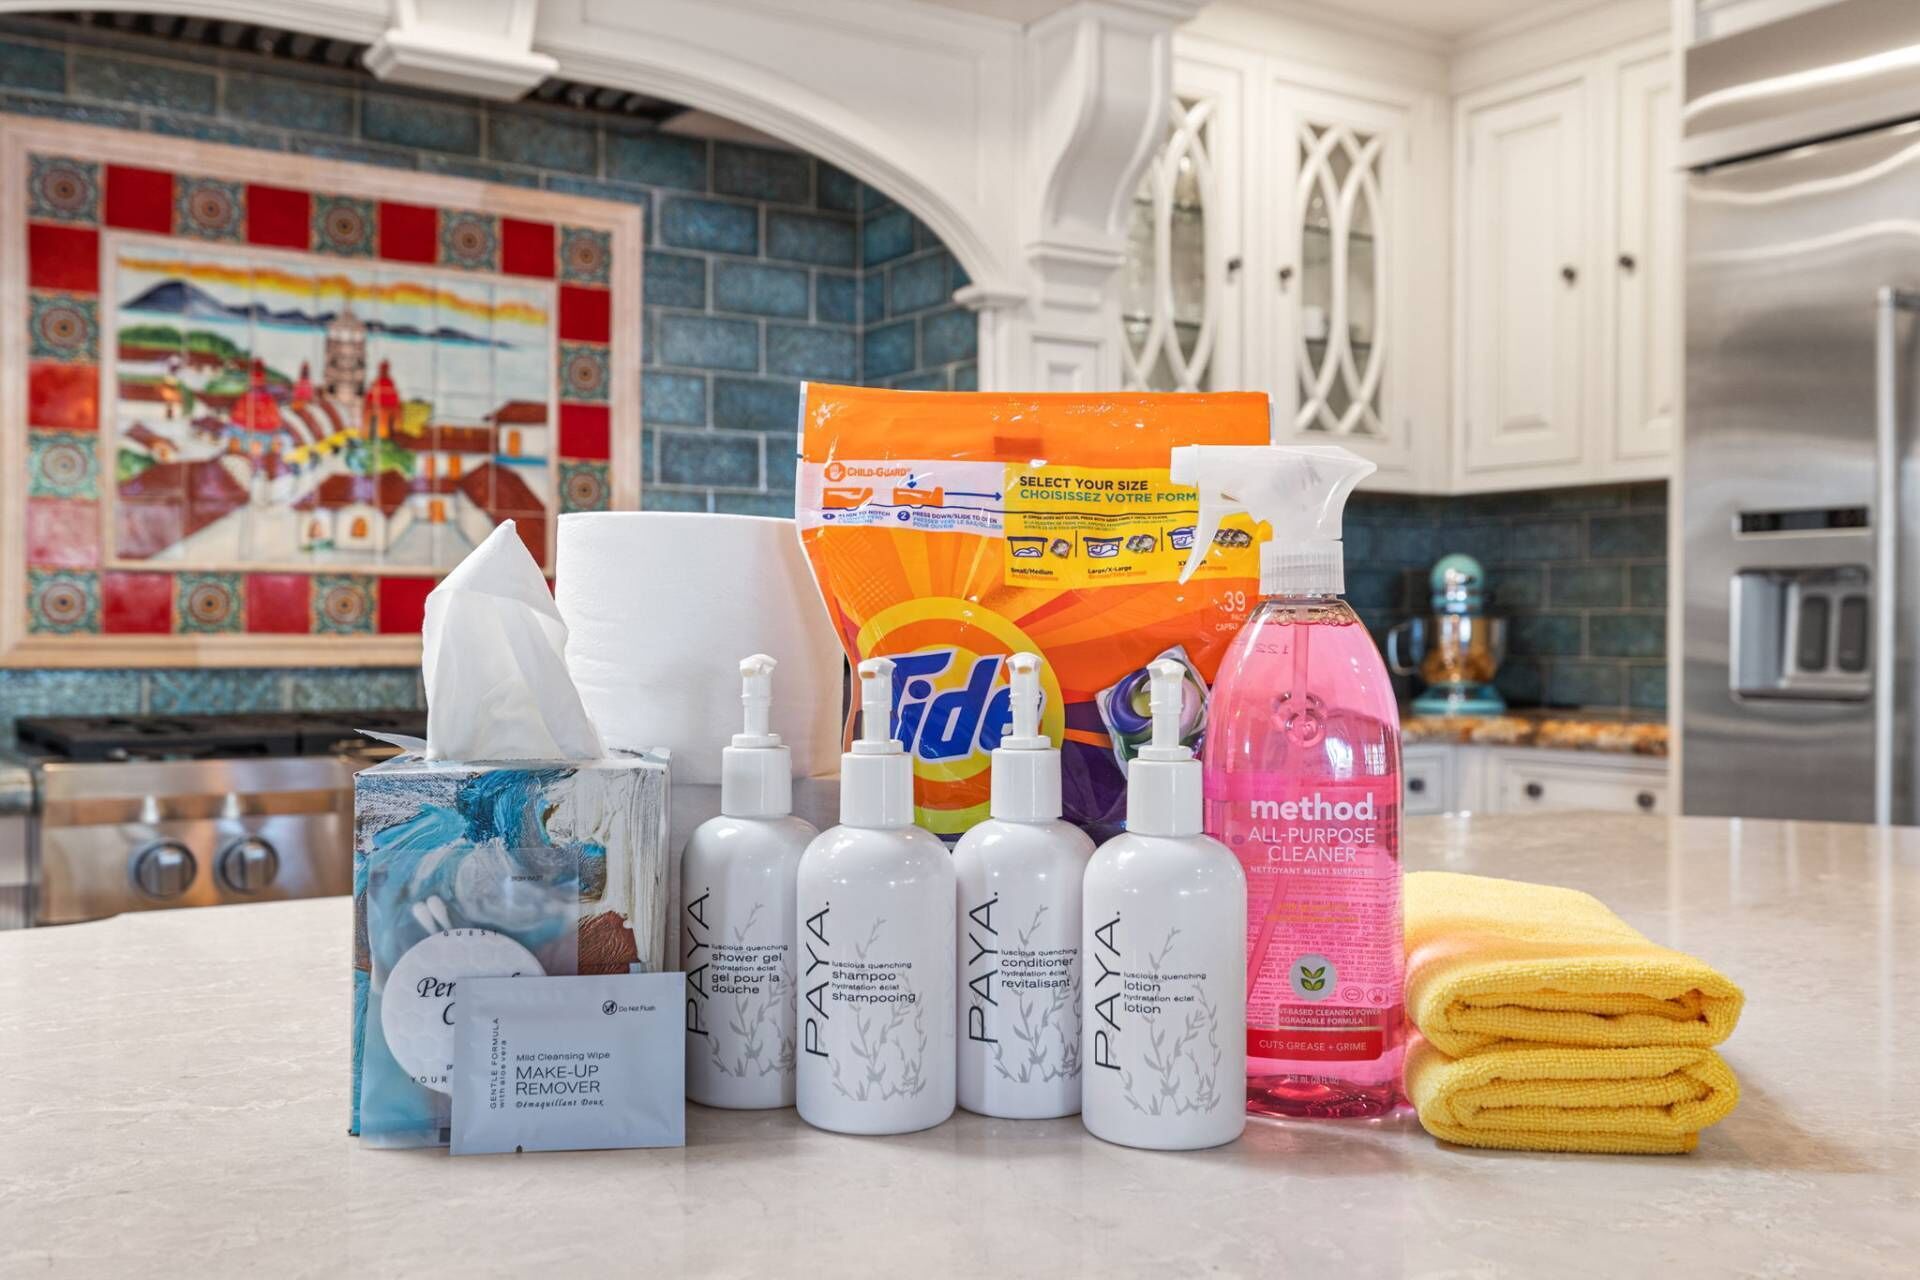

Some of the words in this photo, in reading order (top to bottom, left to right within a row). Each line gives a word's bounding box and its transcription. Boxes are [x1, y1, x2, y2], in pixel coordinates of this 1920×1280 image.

[1019, 475, 1072, 489] SELECT
[1075, 478, 1114, 491] YOUR
[1117, 479, 1149, 491] SIZE
[1020, 488, 1101, 503] CHOISISSEZ
[1105, 492, 1152, 504] VOTRE
[1156, 492, 1197, 503] FORM
[912, 511, 931, 519] PRESS
[1223, 587, 1247, 612] 39
[889, 650, 1046, 761] Tide
[1249, 827, 1376, 844] ALL-PURPOSE
[1268, 846, 1357, 863] CLEANER
[746, 944, 788, 953] quenching
[1001, 948, 1036, 957] luscious
[1038, 948, 1078, 957] quenching
[711, 952, 759, 962] shower
[762, 951, 782, 964] gel
[1001, 957, 1074, 968] conditioner
[832, 960, 865, 969] luscious
[868, 960, 913, 970] quenching
[711, 972, 730, 985] gel
[733, 974, 763, 985] pour
[768, 973, 780, 983] la
[832, 971, 897, 984] shampoo
[1124, 971, 1159, 981] luscious
[1162, 972, 1207, 981] quenching
[711, 983, 760, 995] douche
[1001, 977, 1071, 989] revitalisant
[1124, 980, 1161, 992] lotion
[832, 992, 916, 1004] shampooing
[1124, 1002, 1161, 1014] lotion
[1315, 1009, 1354, 1017] CLEANING
[1327, 1017, 1364, 1026] FORMULA
[491, 1018, 500, 1066] FORMULA
[1259, 1039, 1284, 1050] CUTS
[1287, 1042, 1326, 1051] GREASE
[1335, 1041, 1368, 1052] GRIME
[516, 1054, 536, 1062] Mild
[537, 1053, 585, 1063] Cleansing
[586, 1052, 611, 1062] Wipe
[516, 1064, 600, 1080] MAKE-UP
[489, 1070, 499, 1109] GENTLE
[516, 1081, 600, 1096] REMOVER
